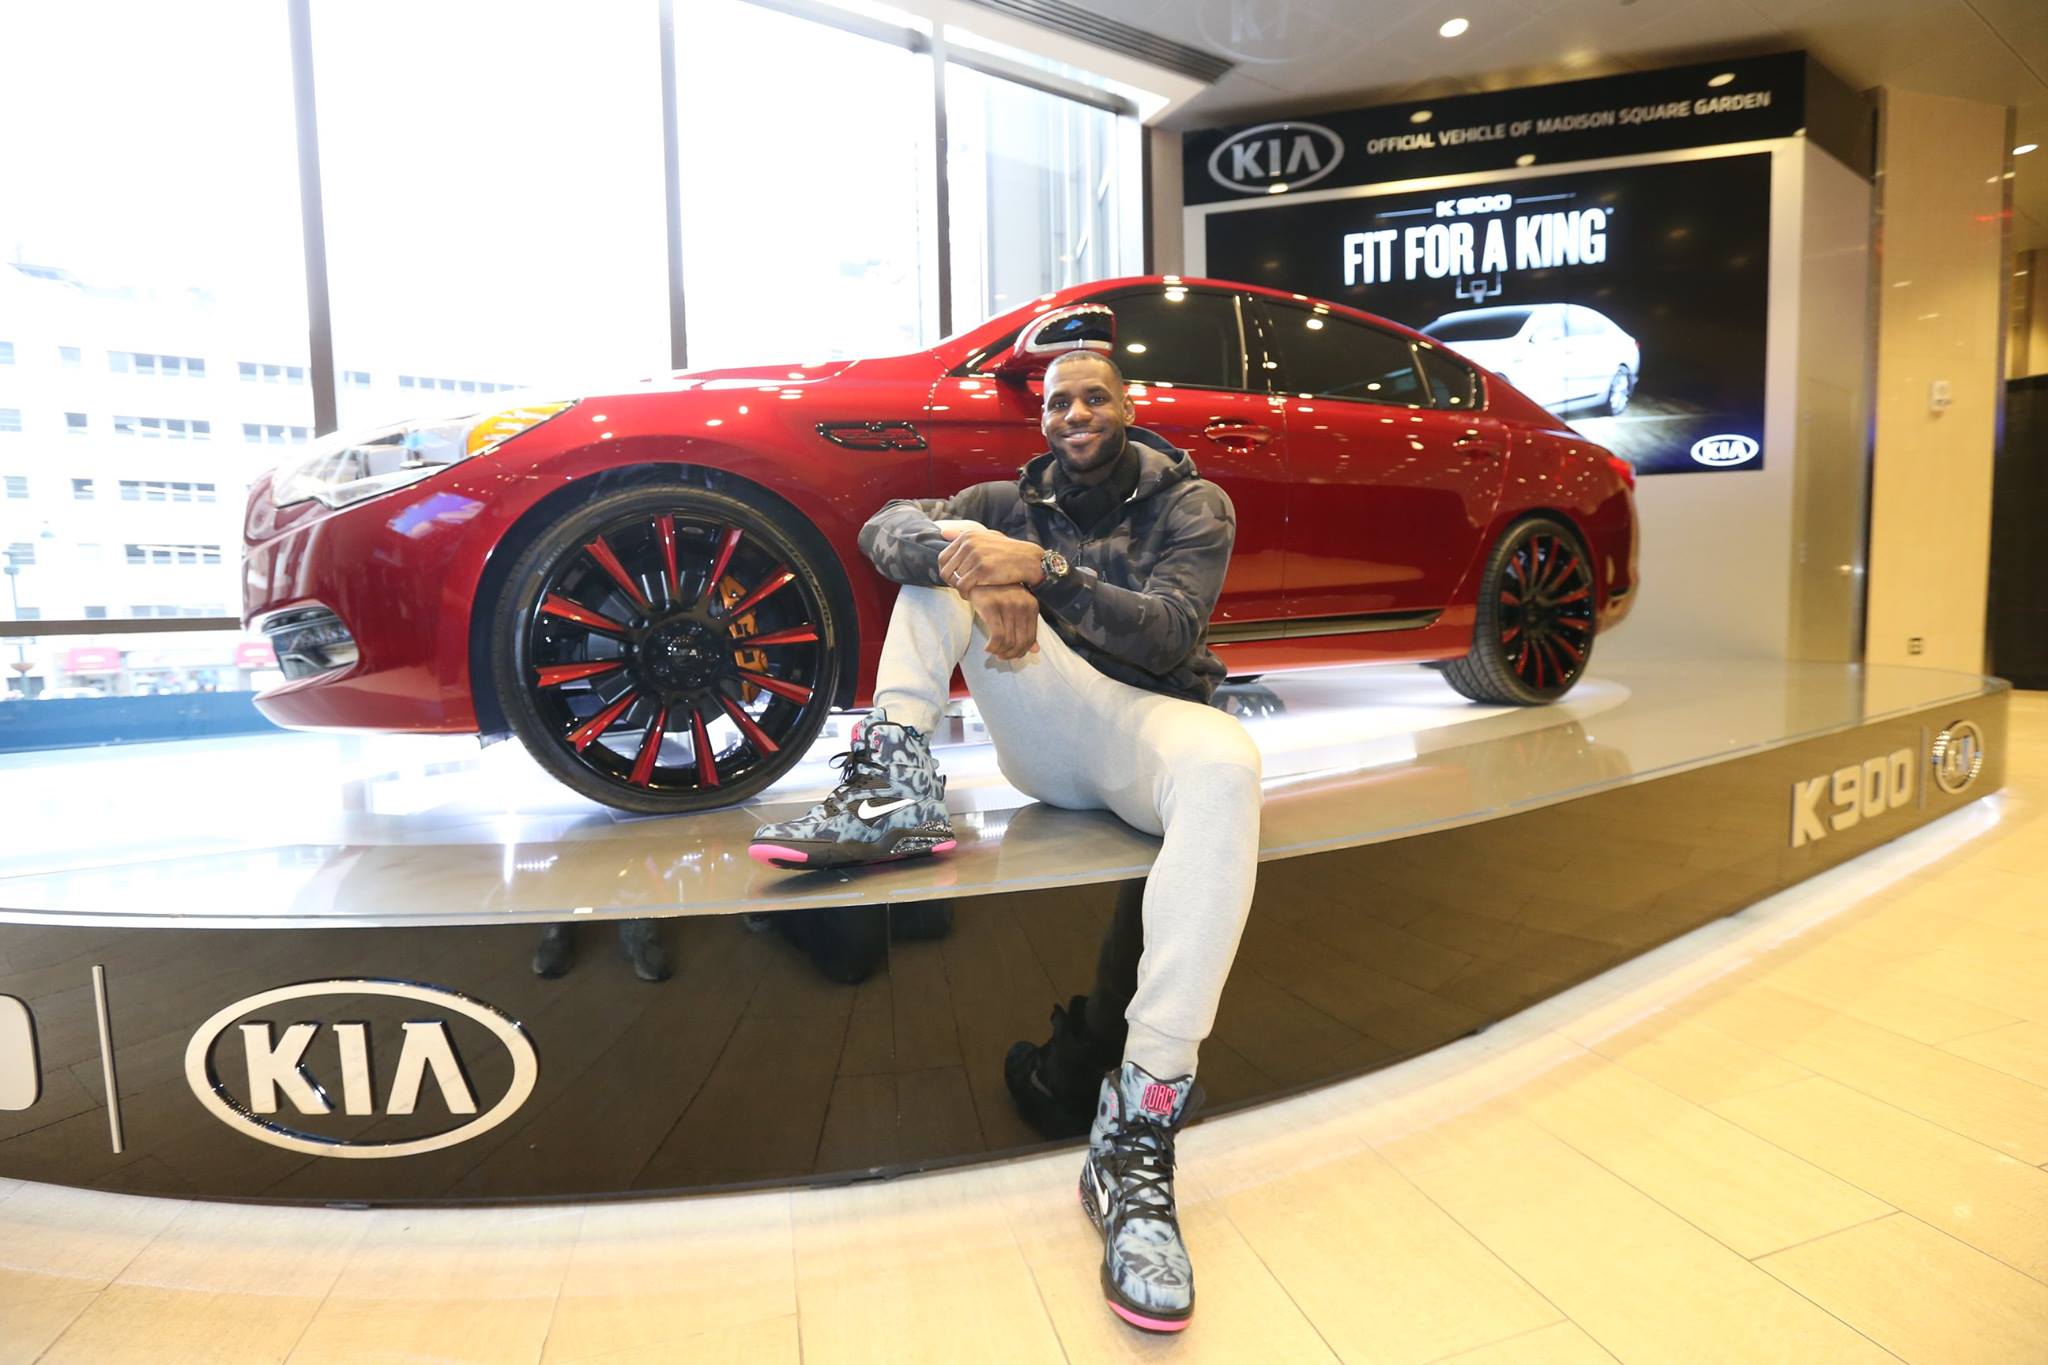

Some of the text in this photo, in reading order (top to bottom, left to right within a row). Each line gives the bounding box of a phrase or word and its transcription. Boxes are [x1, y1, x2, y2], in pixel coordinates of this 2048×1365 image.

[1231, 134, 1321, 181] KIA
[1367, 91, 1772, 155] OFFICIAL VEHICLE OF MADISON SQUARE GARDEN
[1344, 208, 1606, 286] FIT FOR A KING
[238, 1020, 479, 1115] KIA
